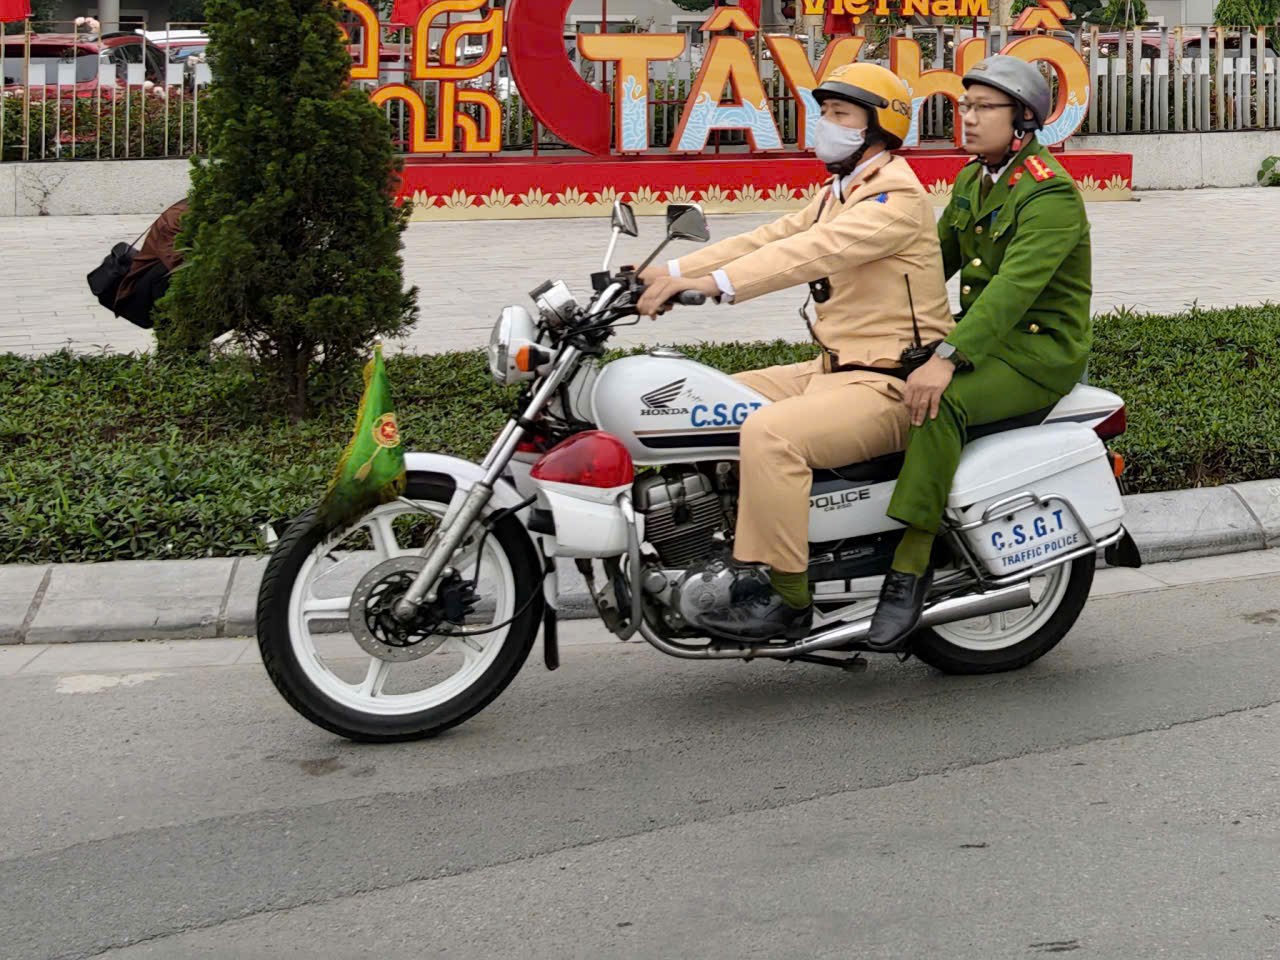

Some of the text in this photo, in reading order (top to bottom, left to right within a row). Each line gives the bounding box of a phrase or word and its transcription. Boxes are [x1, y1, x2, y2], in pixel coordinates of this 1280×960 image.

[578, 6, 867, 154] TÂY
[640, 408, 689, 416] HONDA
[1001, 533, 1079, 567] TRAFFIC POLICE
